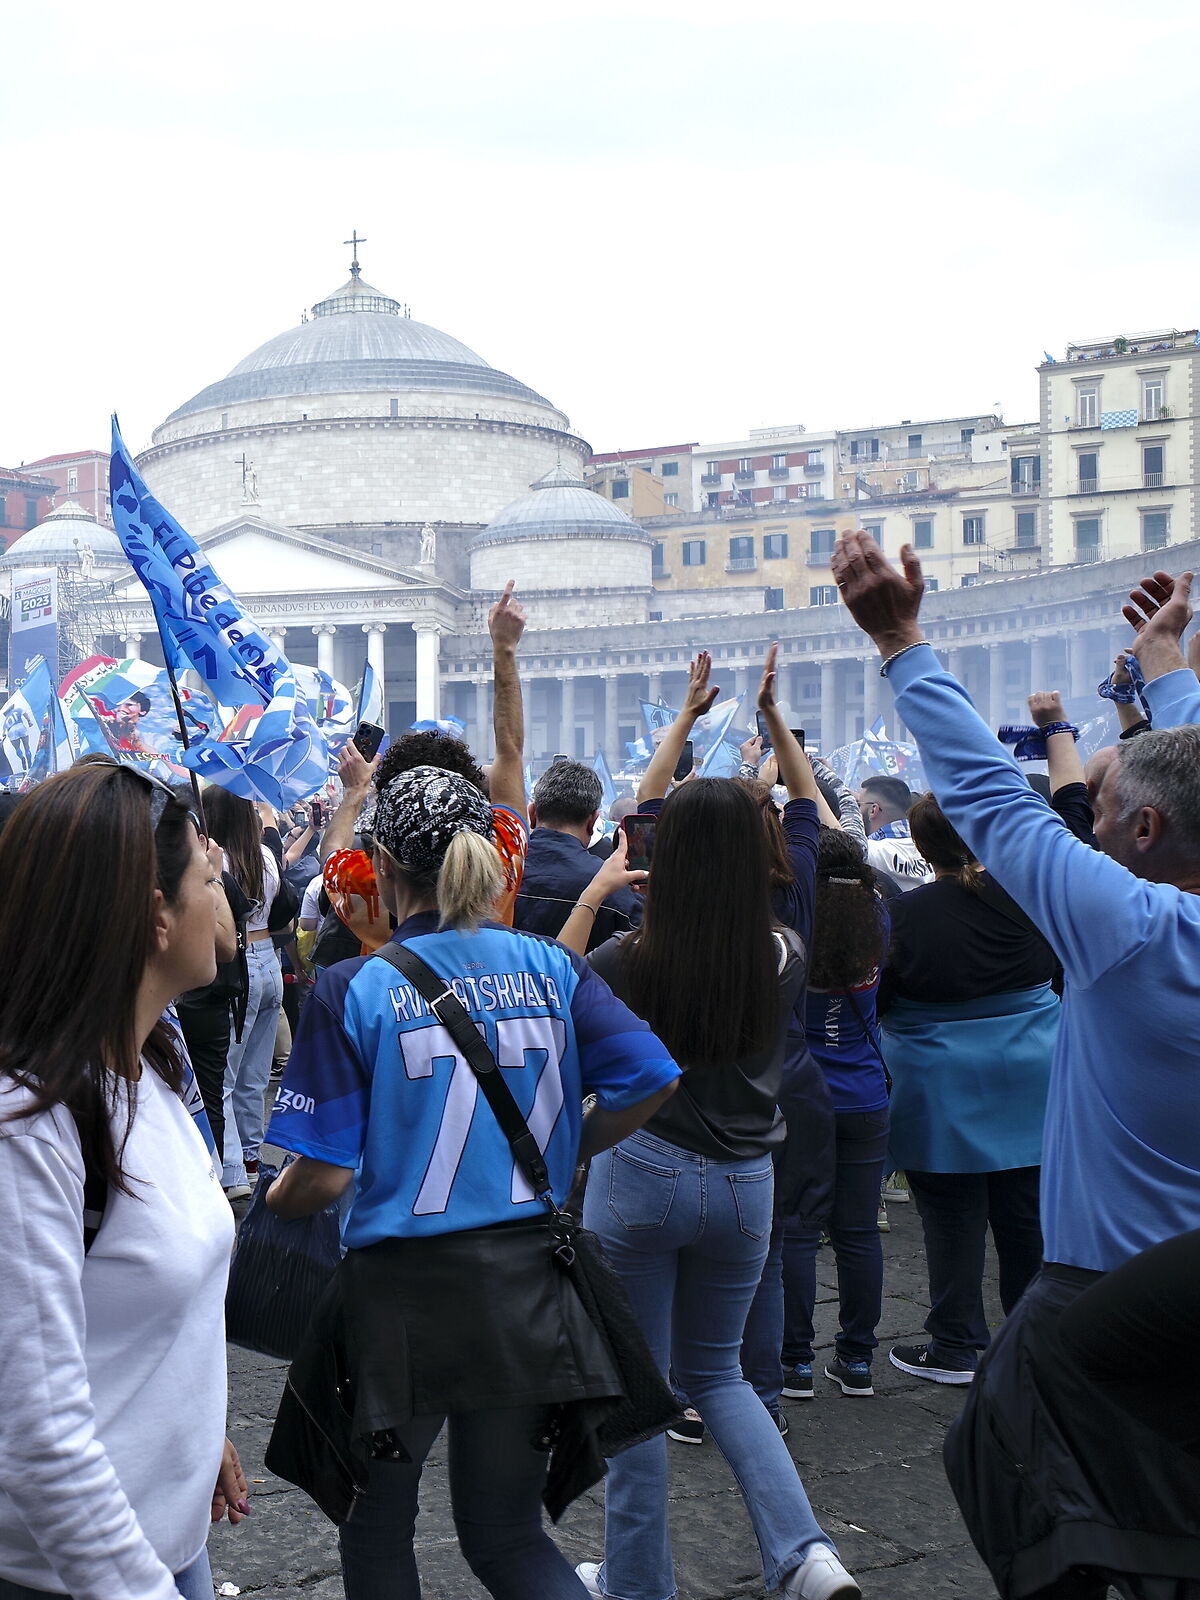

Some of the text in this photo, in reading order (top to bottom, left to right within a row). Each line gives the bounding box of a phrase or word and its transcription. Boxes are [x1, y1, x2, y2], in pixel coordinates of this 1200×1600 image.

[22, 594, 51, 611] 2023
[246, 601, 304, 614] RDINANDVS
[330, 599, 359, 610] VOTO
[398, 1016, 567, 1216] 77
